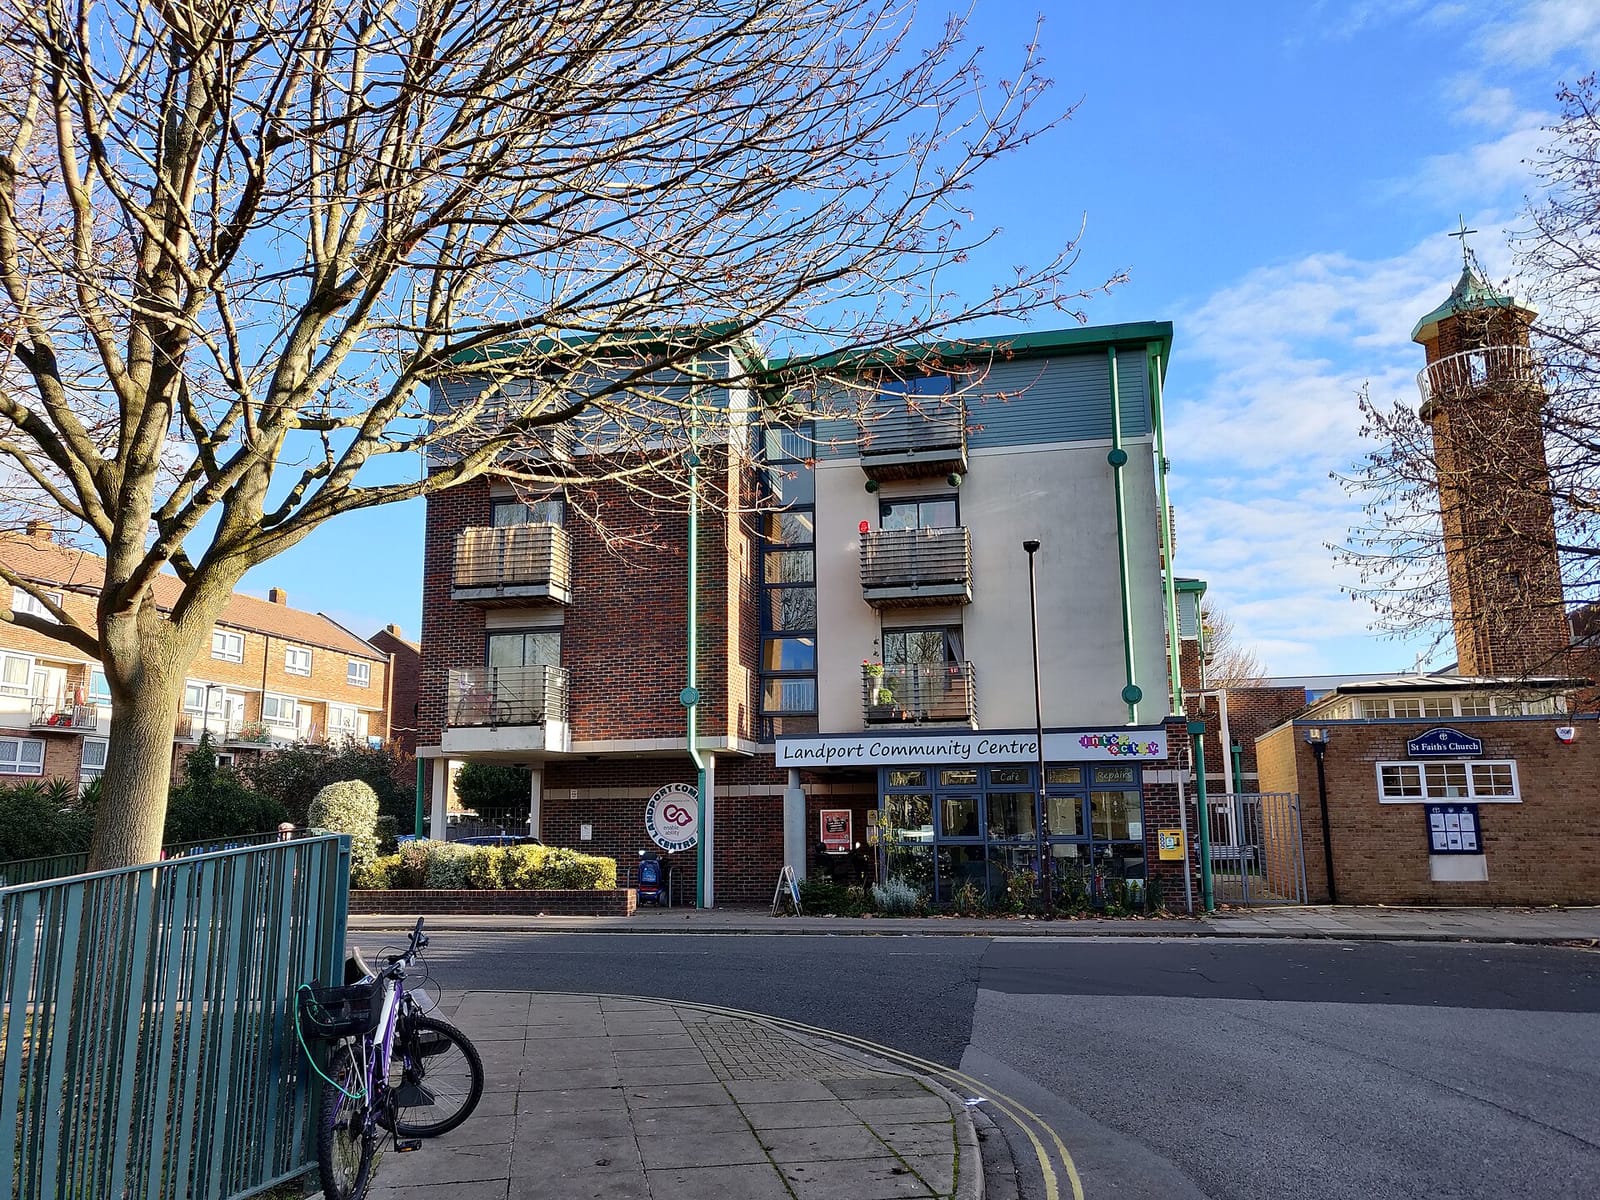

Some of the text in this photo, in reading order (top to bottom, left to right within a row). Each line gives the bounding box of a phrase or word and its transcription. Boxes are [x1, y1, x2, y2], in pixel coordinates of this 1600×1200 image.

[784, 739, 1038, 764] Landport Community Centre
[1410, 742, 1479, 751] St Faith's Church
[646, 785, 673, 838] LANDPORT
[658, 837, 697, 850] CENTRE
